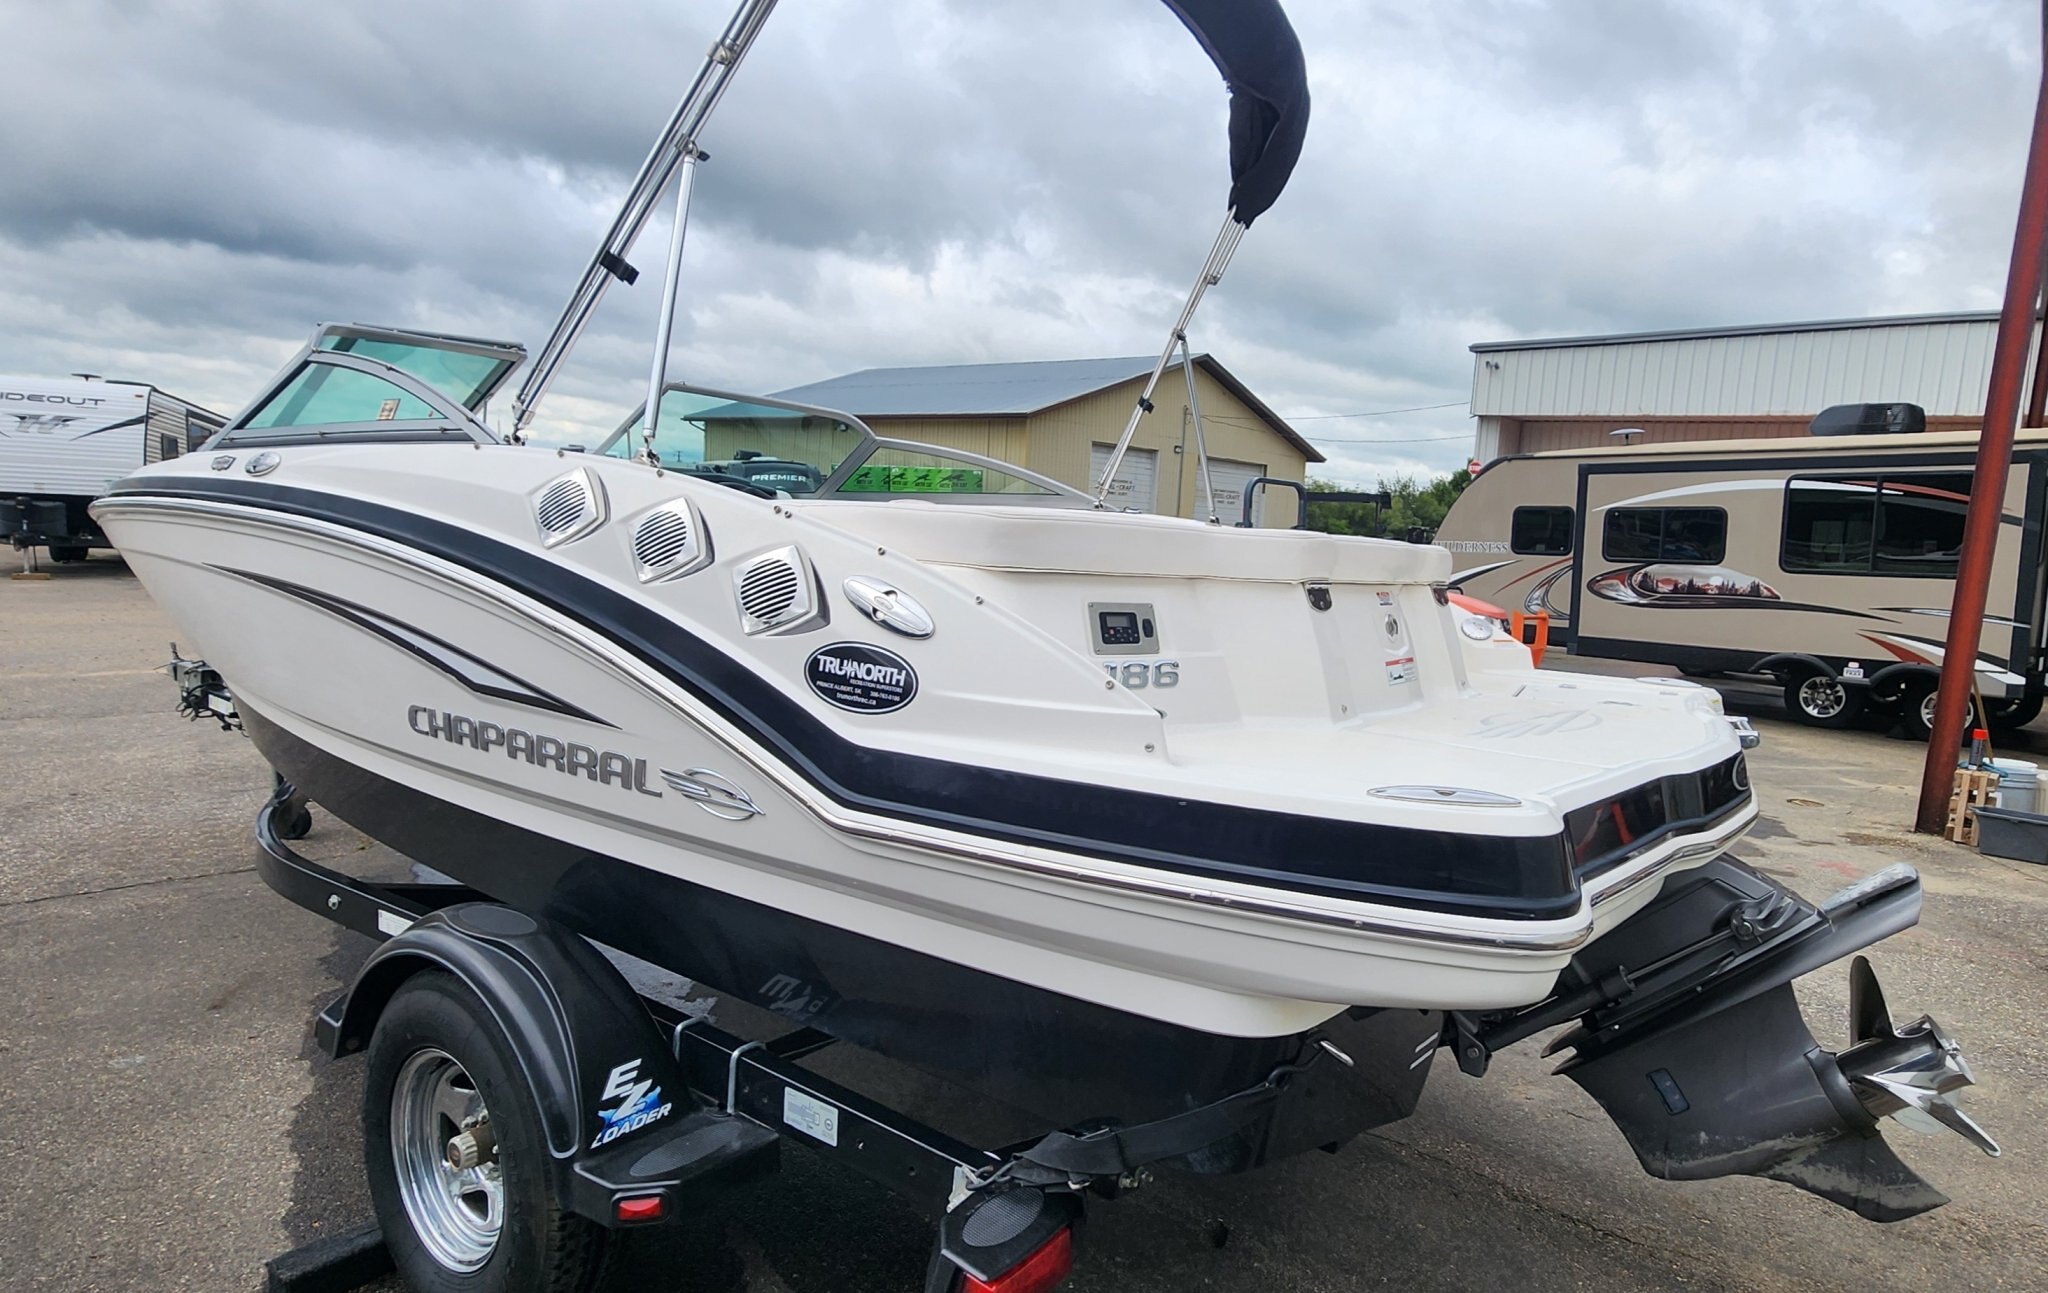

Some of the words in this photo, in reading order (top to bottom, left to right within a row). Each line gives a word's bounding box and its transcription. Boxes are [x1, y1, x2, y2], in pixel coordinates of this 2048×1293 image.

[0, 392, 105, 406] IDEOUT
[751, 474, 807, 482] PREMIER
[408, 704, 663, 798] CHAPARRAL
[590, 1102, 673, 1149] LOADER
